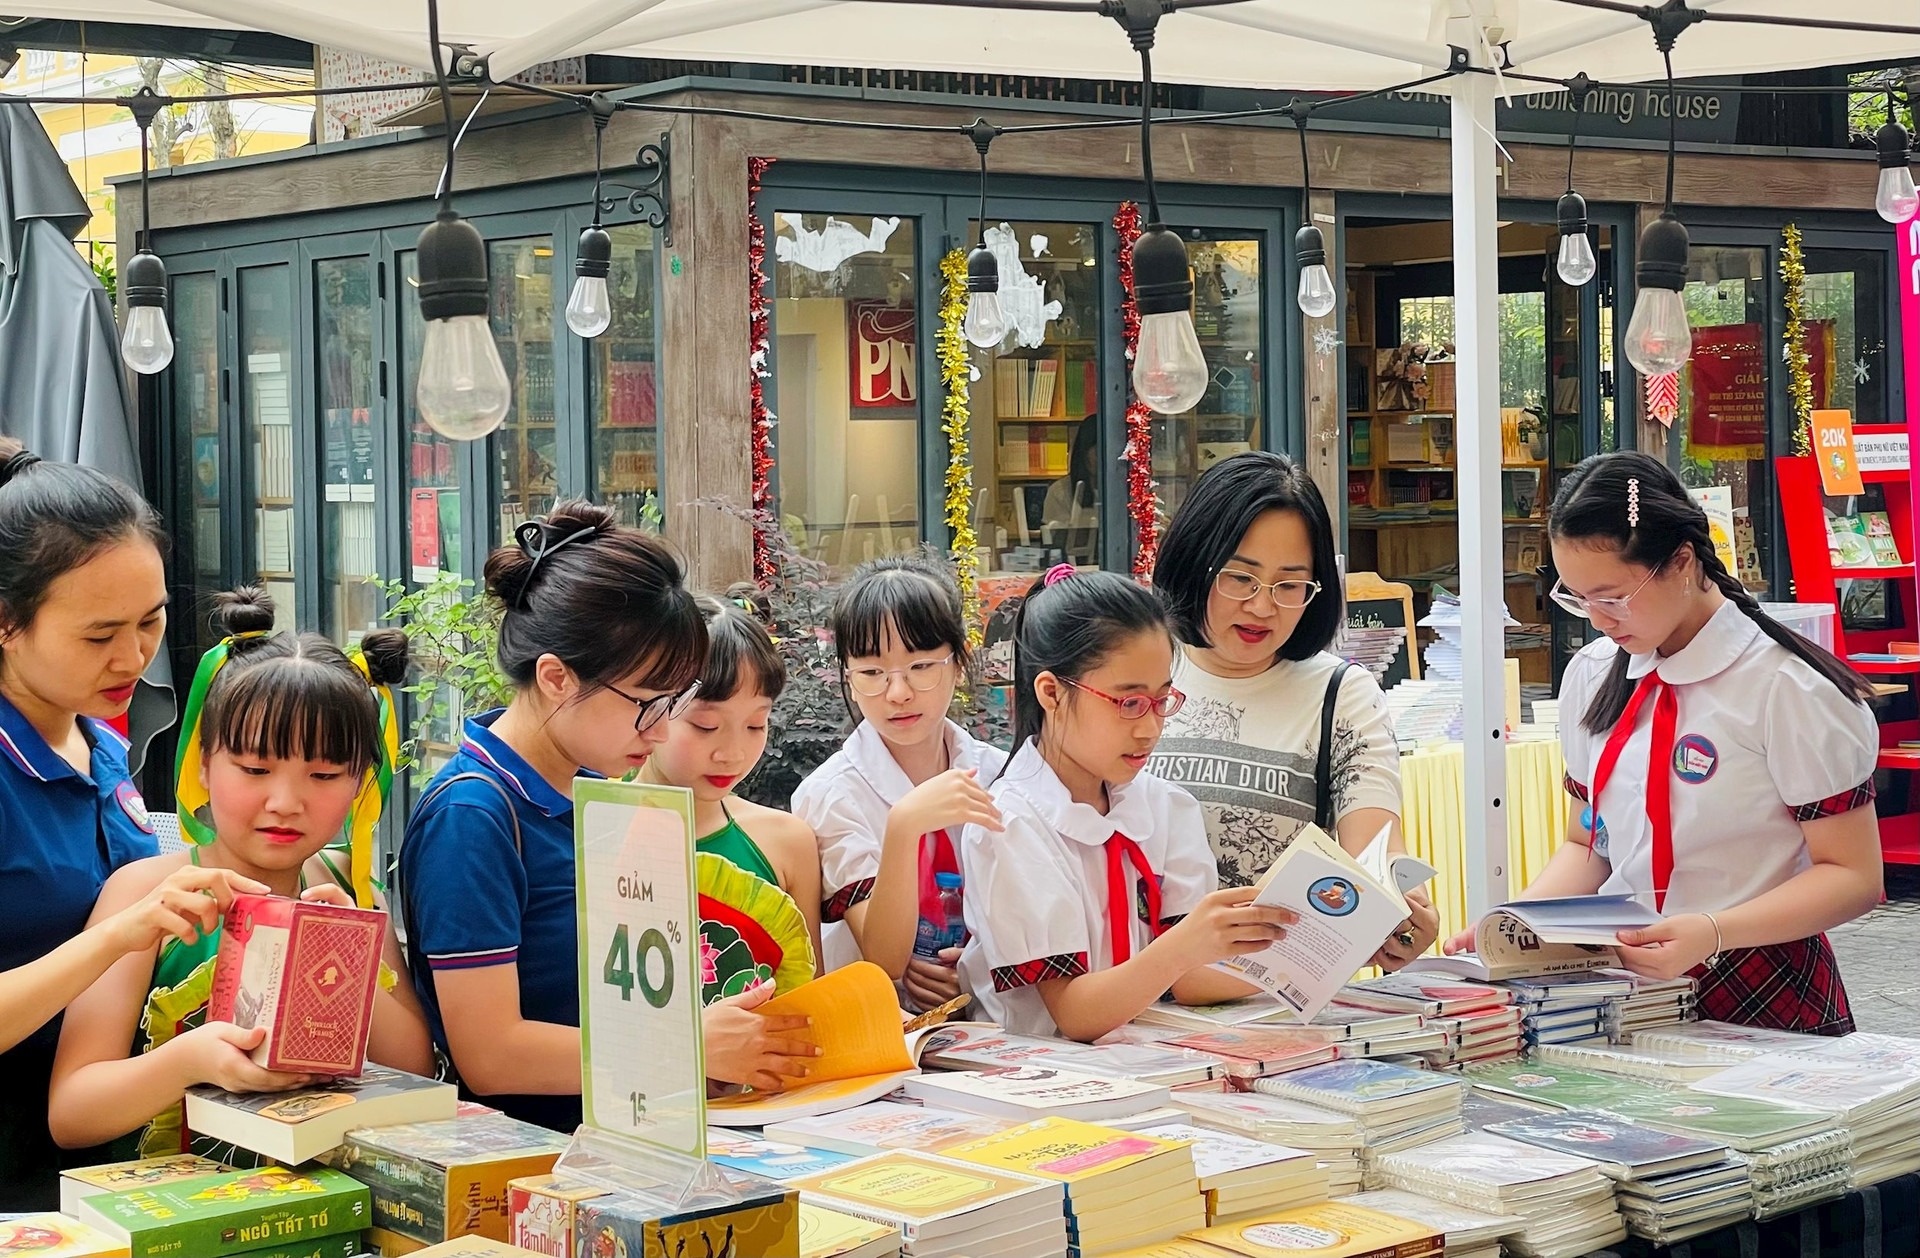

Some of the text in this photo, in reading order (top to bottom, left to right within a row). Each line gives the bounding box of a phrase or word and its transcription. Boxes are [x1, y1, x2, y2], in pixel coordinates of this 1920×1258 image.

[1643, 89, 1721, 120] house
[1821, 428, 1847, 447] 20K
[1144, 757, 1290, 797] HRISTIAN DIOR
[617, 871, 653, 903] GIẢM
[603, 923, 675, 1009] 40
[240, 1208, 328, 1242] NGÔ TẤT TỐ
